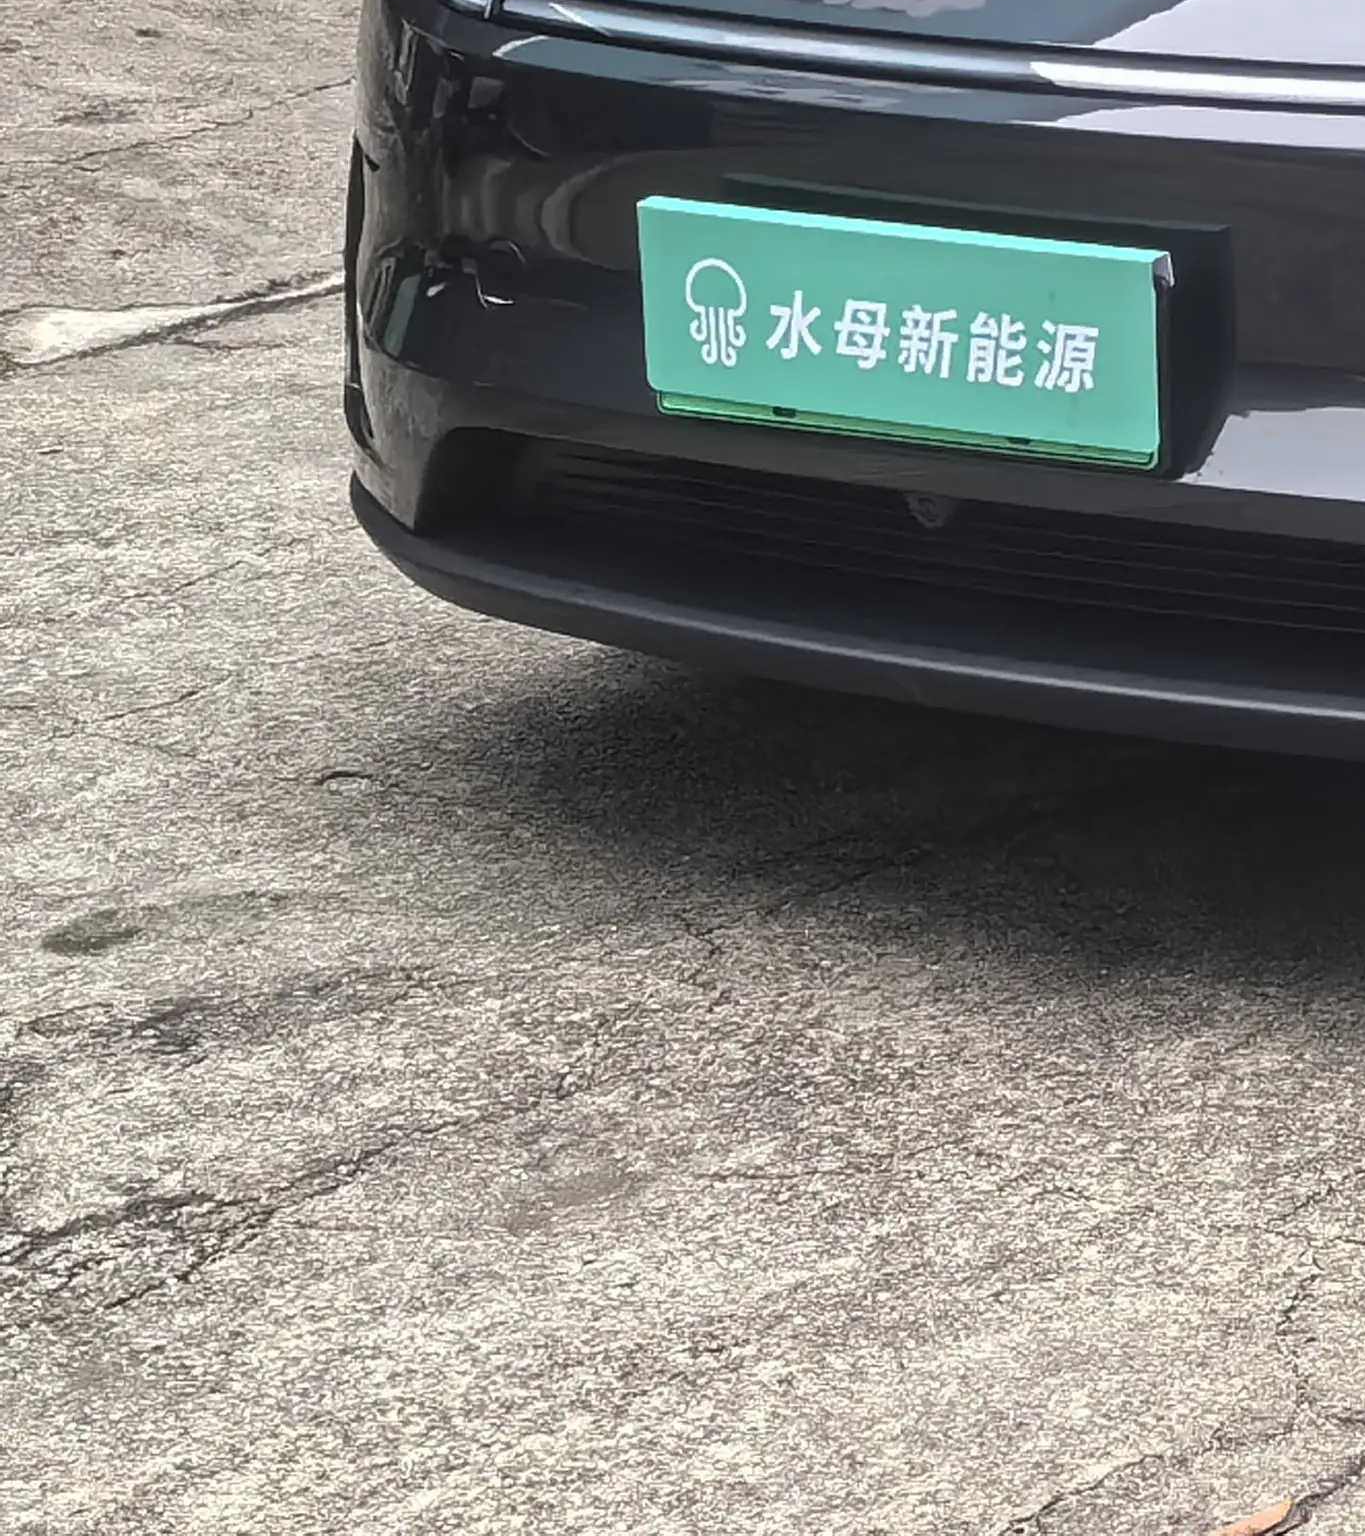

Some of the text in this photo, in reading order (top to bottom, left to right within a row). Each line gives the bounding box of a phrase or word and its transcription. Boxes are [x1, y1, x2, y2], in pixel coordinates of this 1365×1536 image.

[765, 289, 1100, 394] 水母新能源
